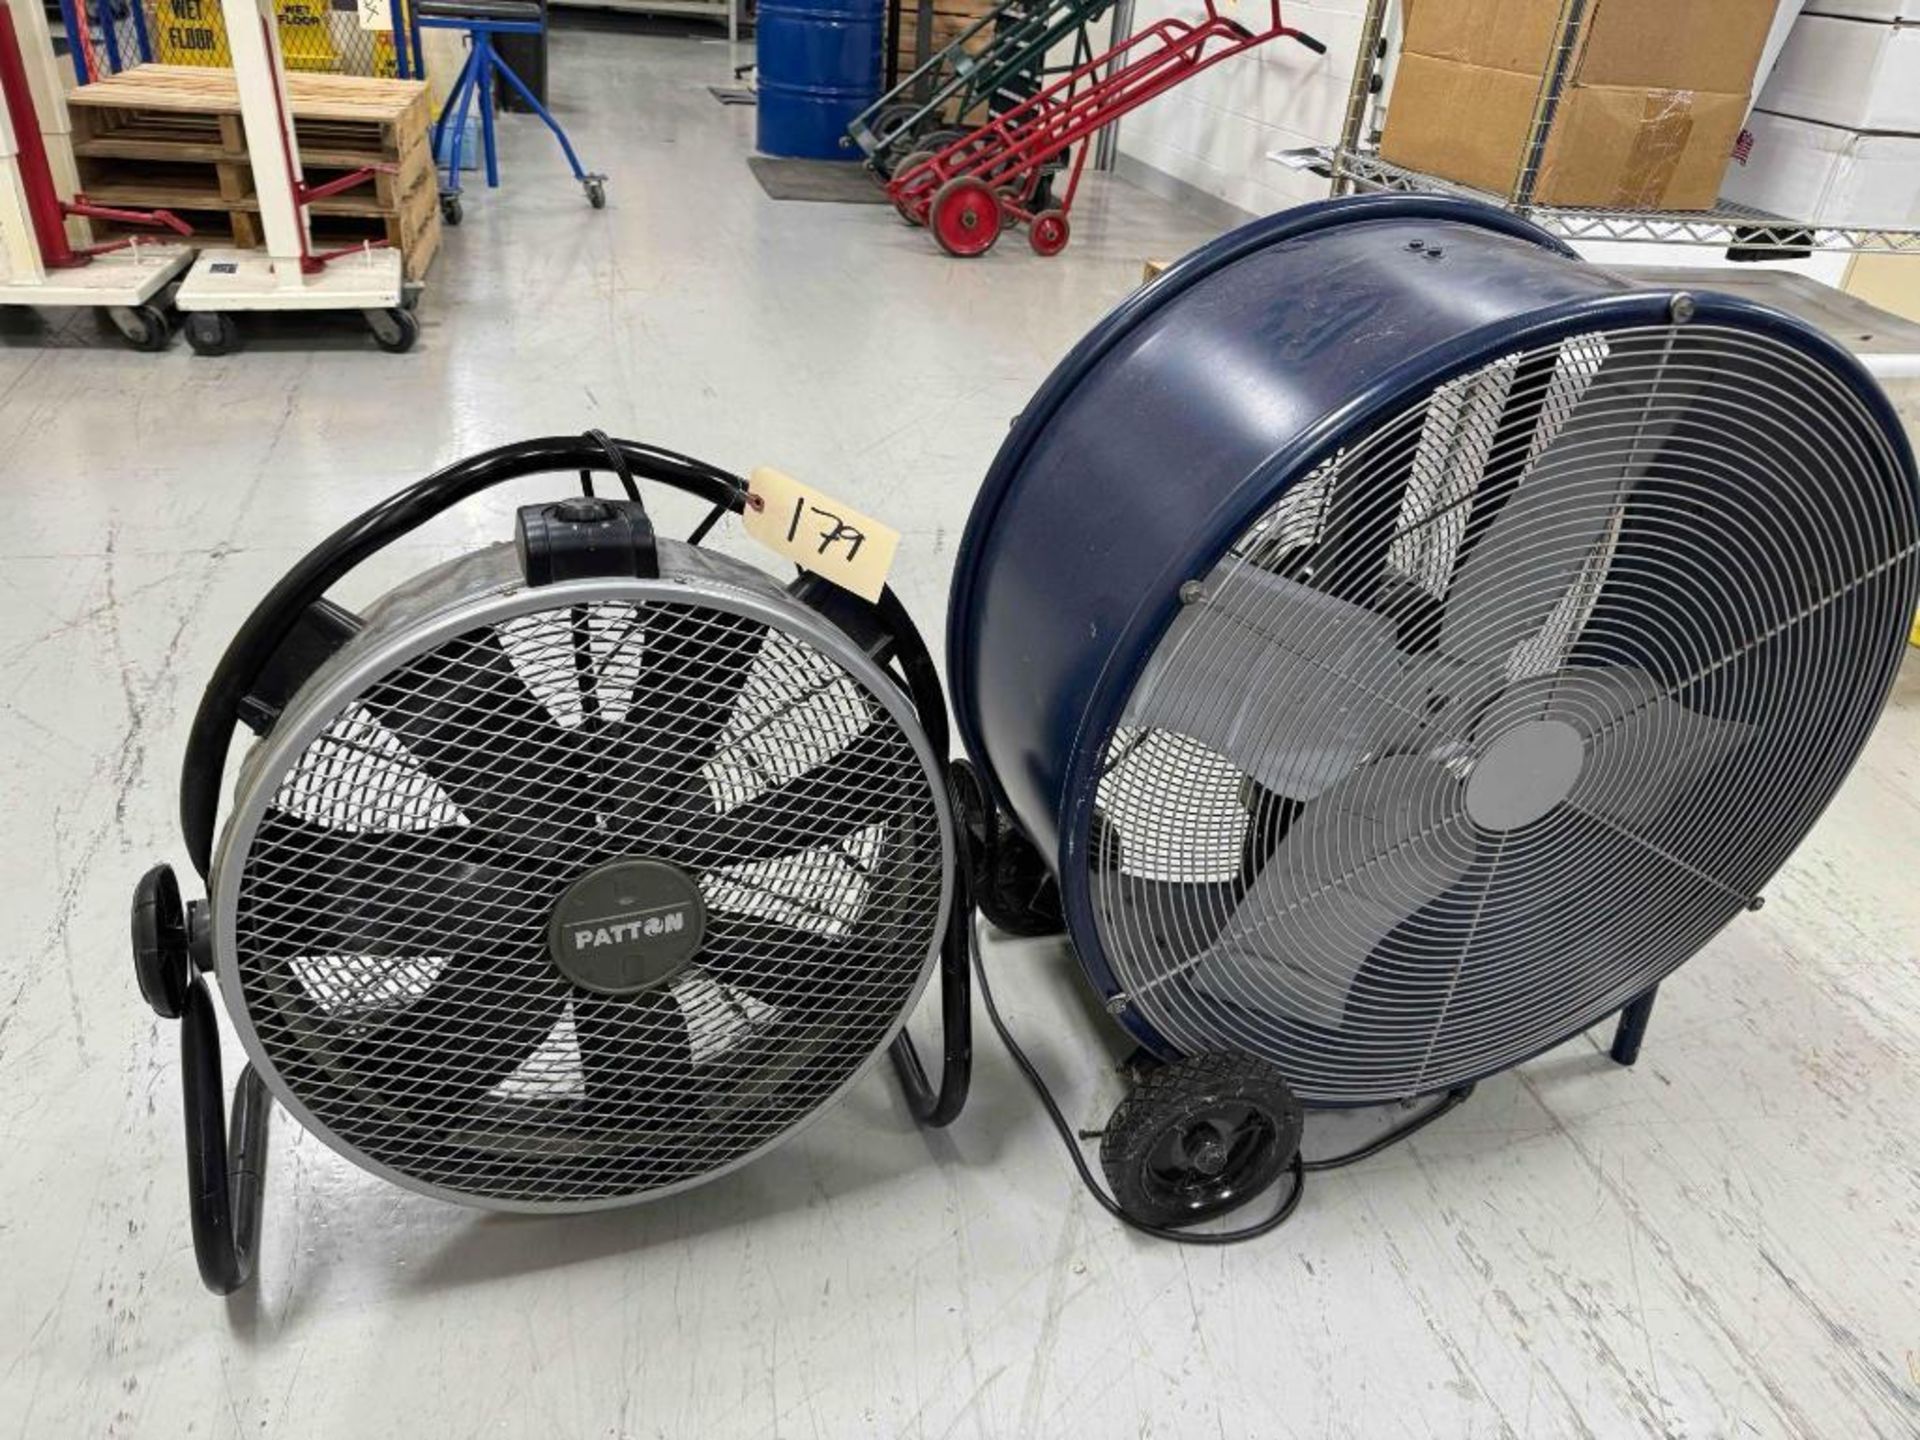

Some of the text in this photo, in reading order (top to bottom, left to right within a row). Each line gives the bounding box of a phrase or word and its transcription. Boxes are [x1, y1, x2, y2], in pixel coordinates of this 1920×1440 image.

[171, 0, 205, 20] WET
[277, 14, 320, 26] FLOOR
[283, 4, 311, 15] WET
[168, 27, 216, 50] FLOOR
[786, 496, 866, 562] 179
[574, 912, 684, 950] PATTON
